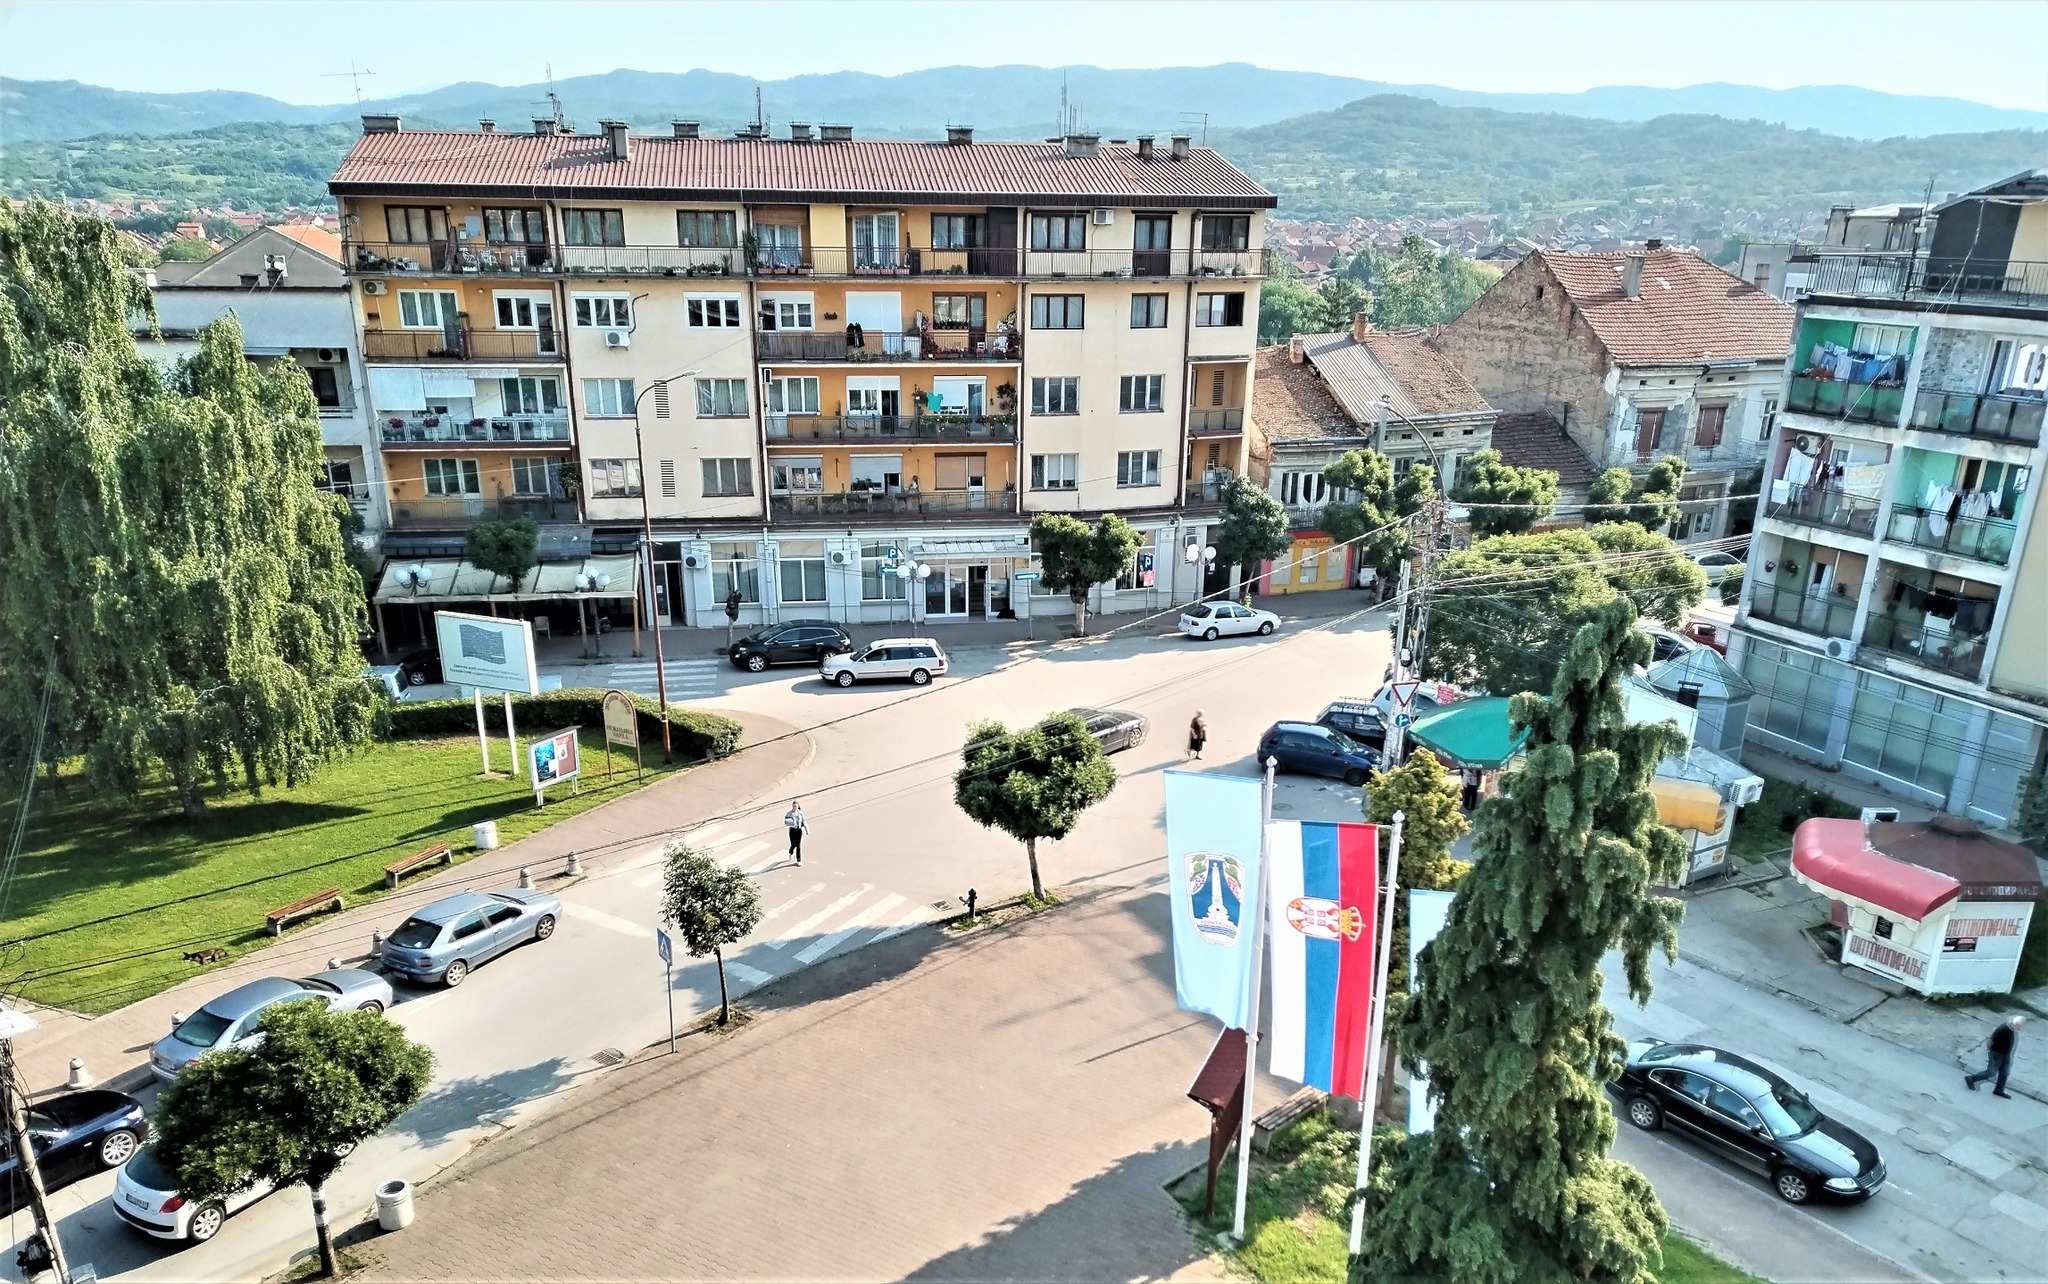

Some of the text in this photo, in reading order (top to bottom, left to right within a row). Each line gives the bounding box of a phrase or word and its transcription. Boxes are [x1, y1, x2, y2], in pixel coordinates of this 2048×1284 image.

[1145, 556, 1151, 567] P
[1946, 918, 2024, 936] ФОТОКОПИРАЊЕ
[1849, 935, 1928, 981] ФОТОКОПИРАЊЕ
